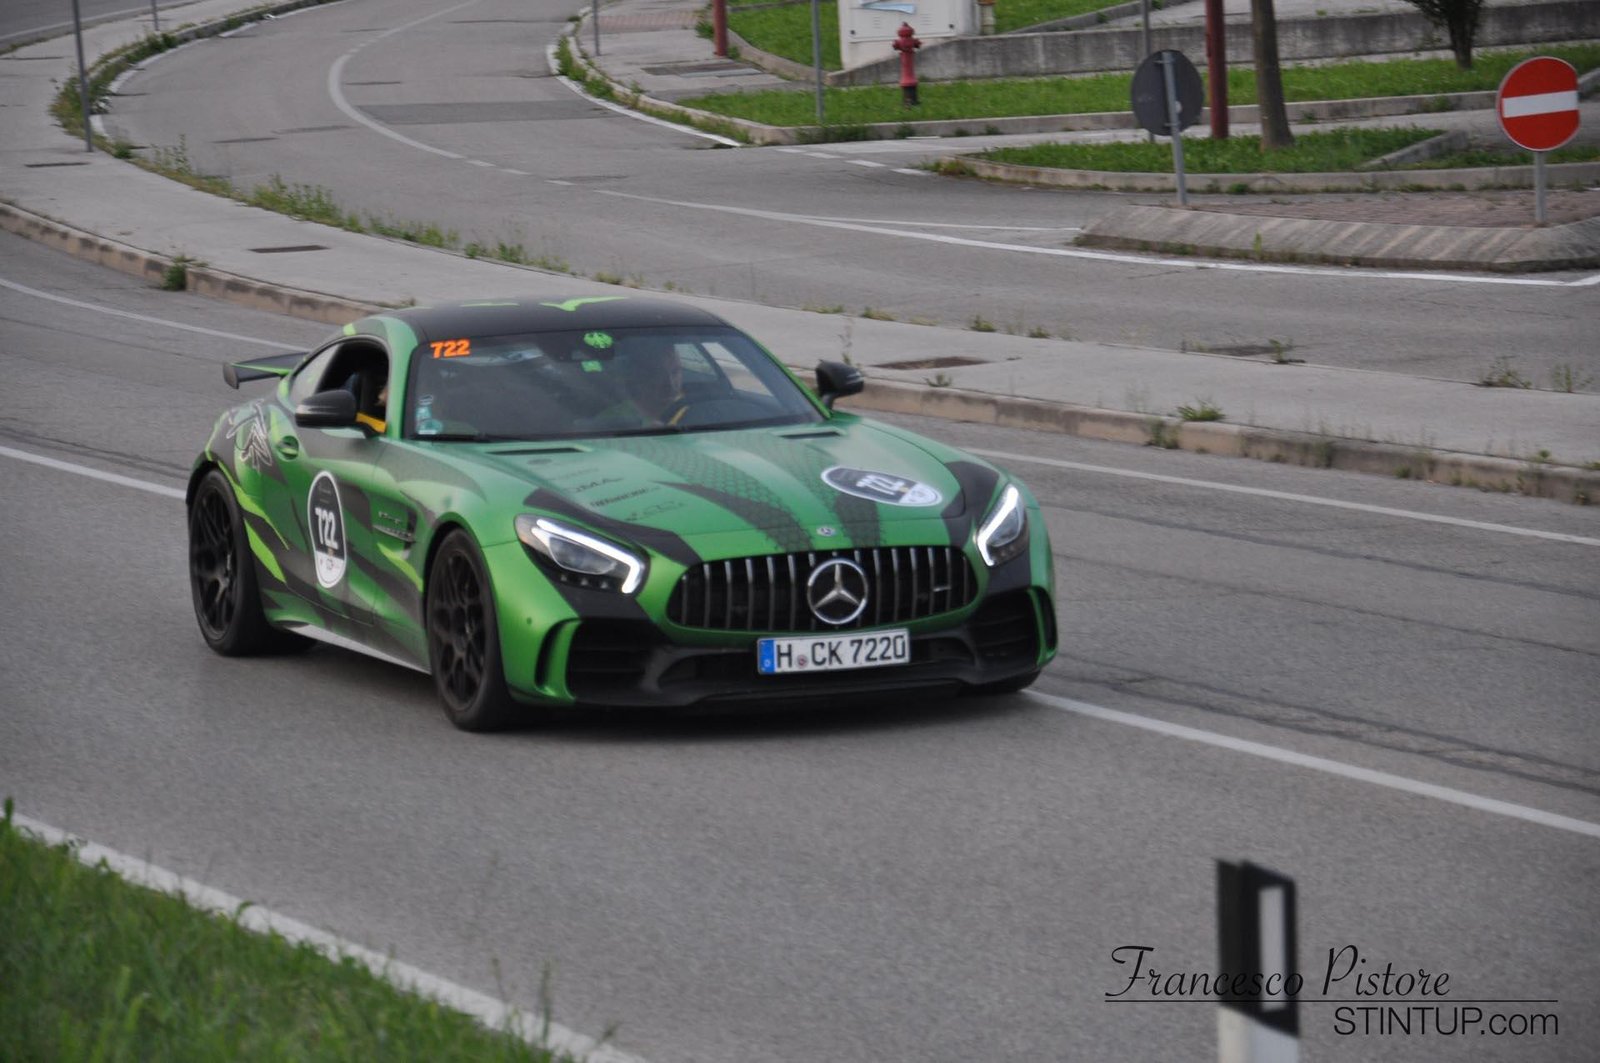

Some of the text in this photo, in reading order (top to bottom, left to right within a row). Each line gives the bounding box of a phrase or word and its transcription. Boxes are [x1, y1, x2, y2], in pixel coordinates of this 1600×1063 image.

[430, 338, 471, 359] 722
[314, 506, 339, 550] 722
[776, 643, 793, 668] H
[811, 641, 843, 667] CK
[850, 634, 906, 664] 7220
